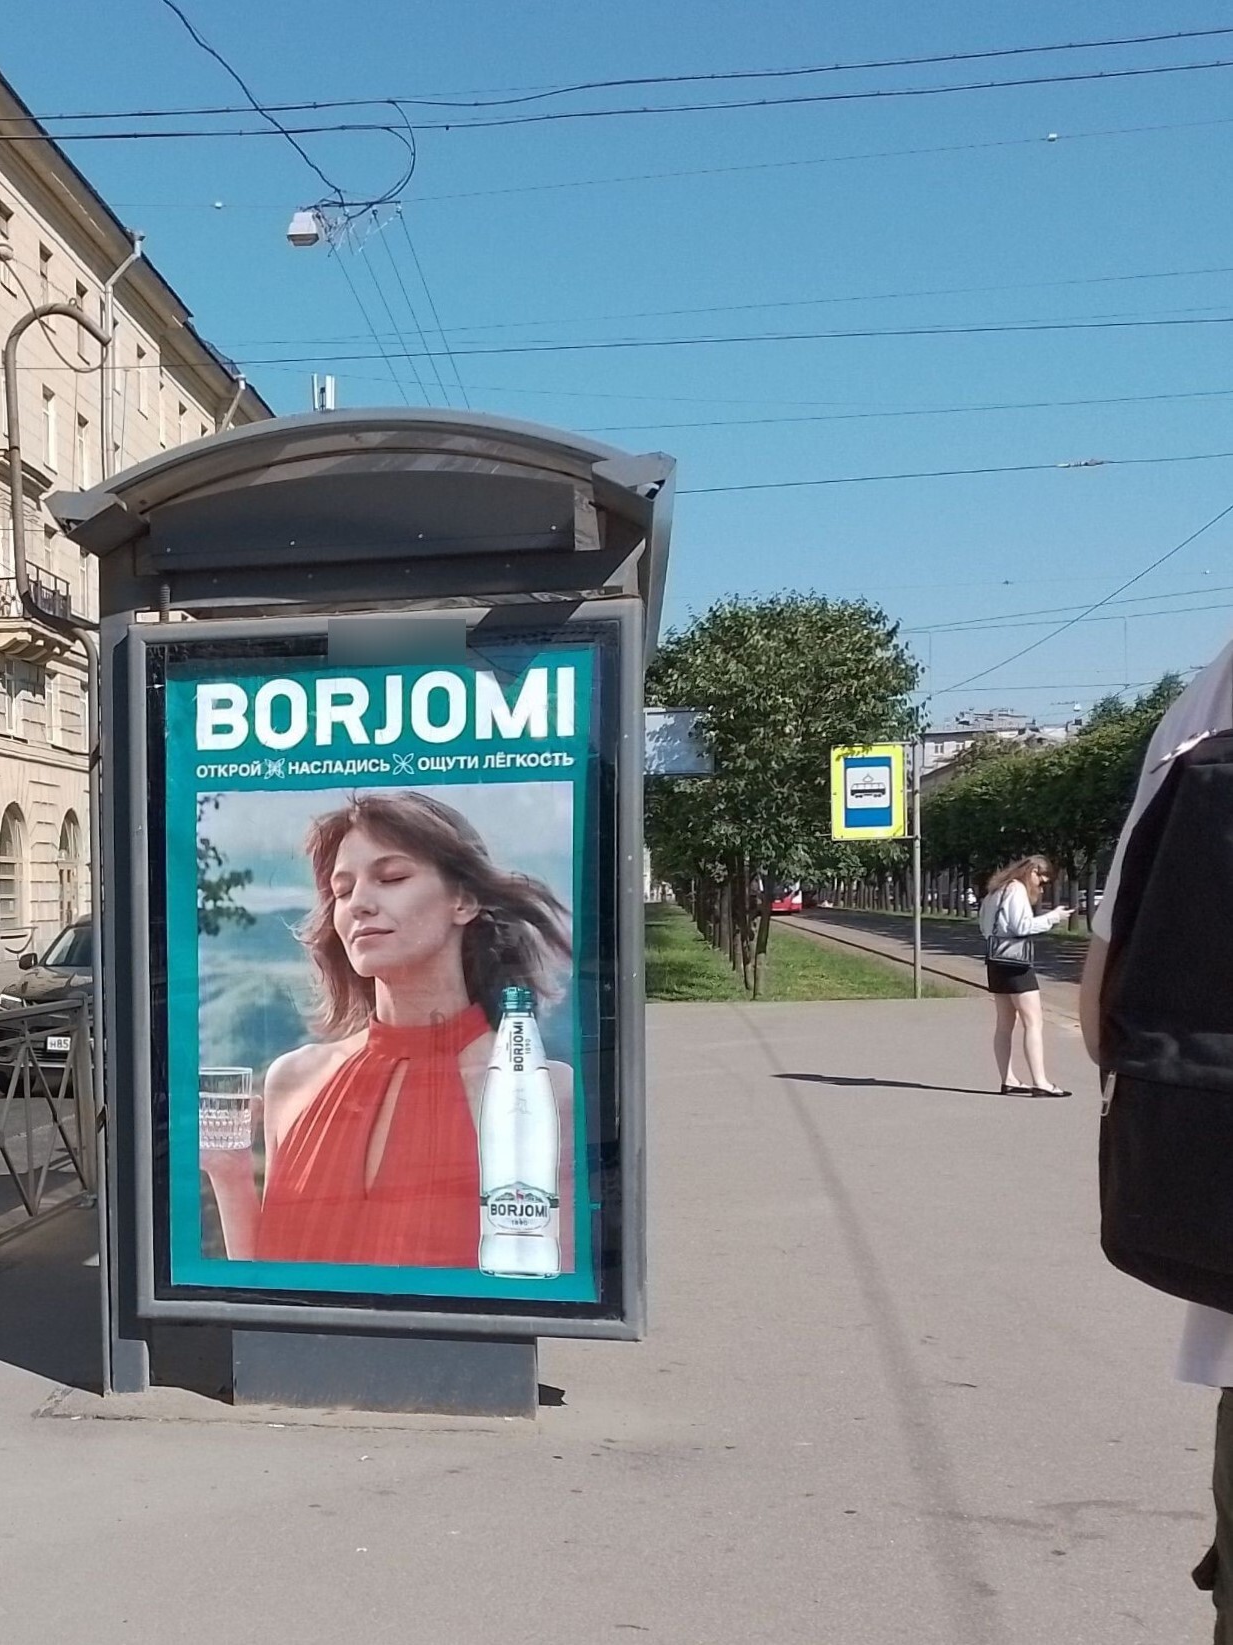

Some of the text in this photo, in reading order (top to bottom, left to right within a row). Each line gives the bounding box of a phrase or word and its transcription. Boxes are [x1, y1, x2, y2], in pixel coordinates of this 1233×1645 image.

[196, 667, 575, 751] BORJOMI
[196, 752, 575, 779] ОТКРОЙ НАСЛАДИСЬ ОЩУТИ ЛЁГКОСТЬ
[49, 1038, 70, 1049] Н85
[512, 1021, 524, 1072] BORJOMI
[490, 1203, 548, 1218] BORJOMI
